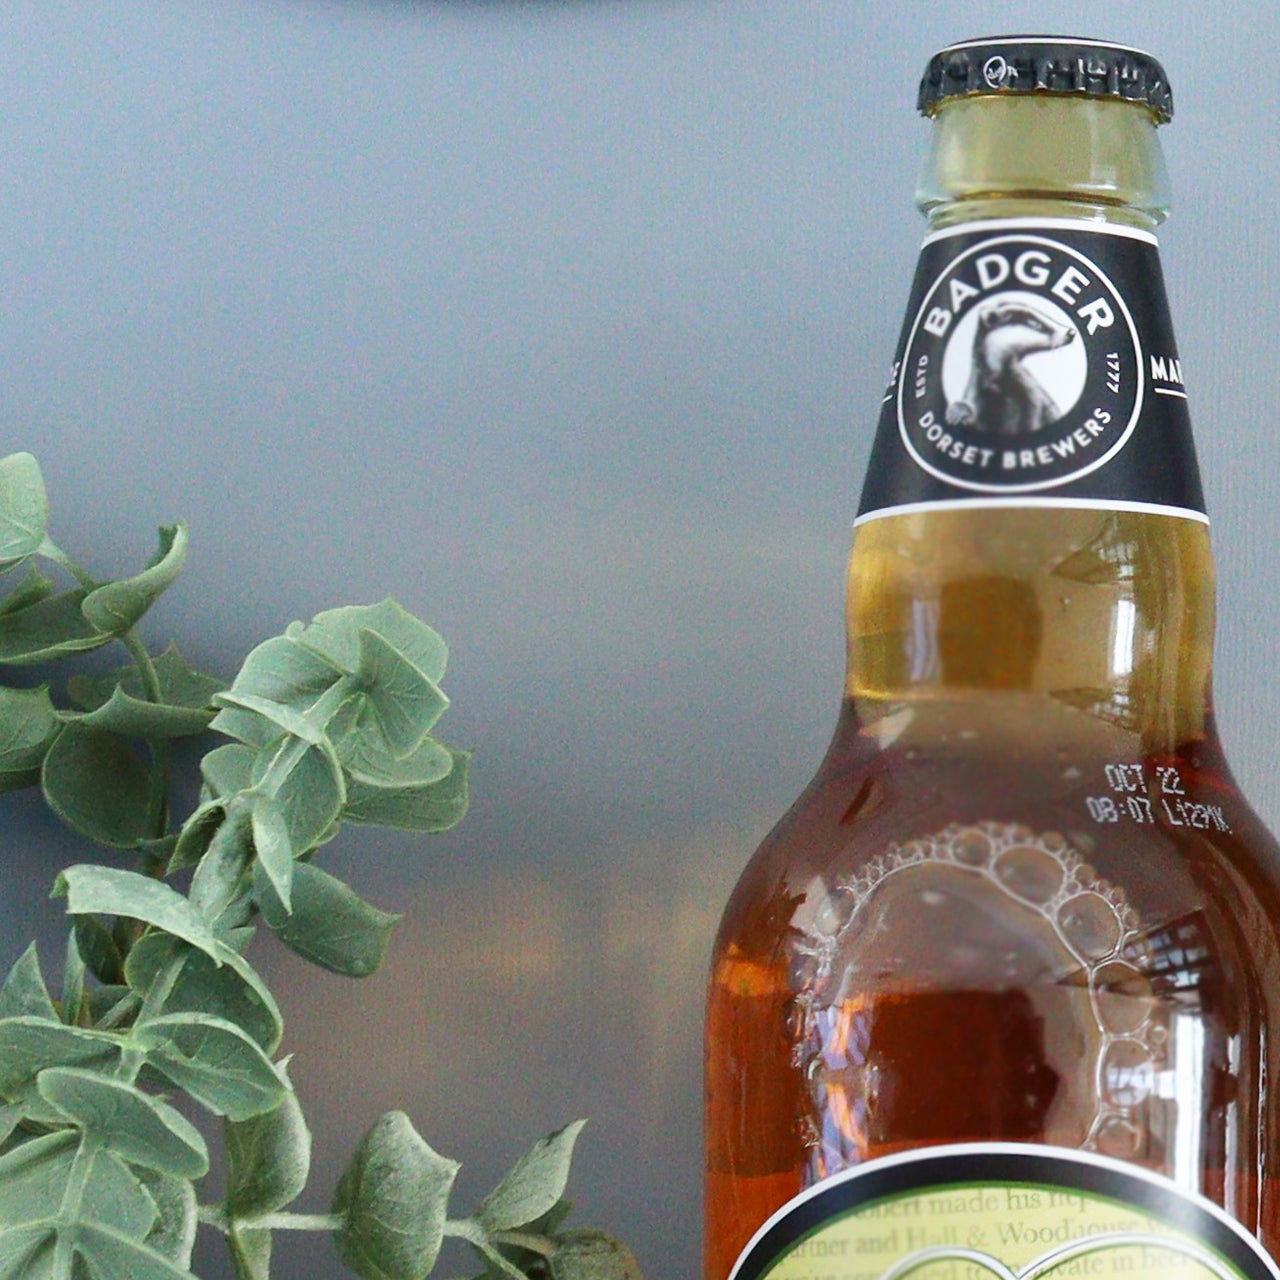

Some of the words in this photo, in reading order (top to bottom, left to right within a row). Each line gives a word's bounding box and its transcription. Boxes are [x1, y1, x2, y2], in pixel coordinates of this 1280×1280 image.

[923, 250, 1117, 337] BADGER
[914, 354, 929, 399] ESTD
[1106, 352, 1121, 394] 1777
[918, 409, 995, 468] DORSET
[1002, 407, 1112, 469] BREWERS
[1104, 763, 1148, 793] OCT
[1085, 795, 1155, 824] 08:07
[854, 1228, 899, 1255] and
